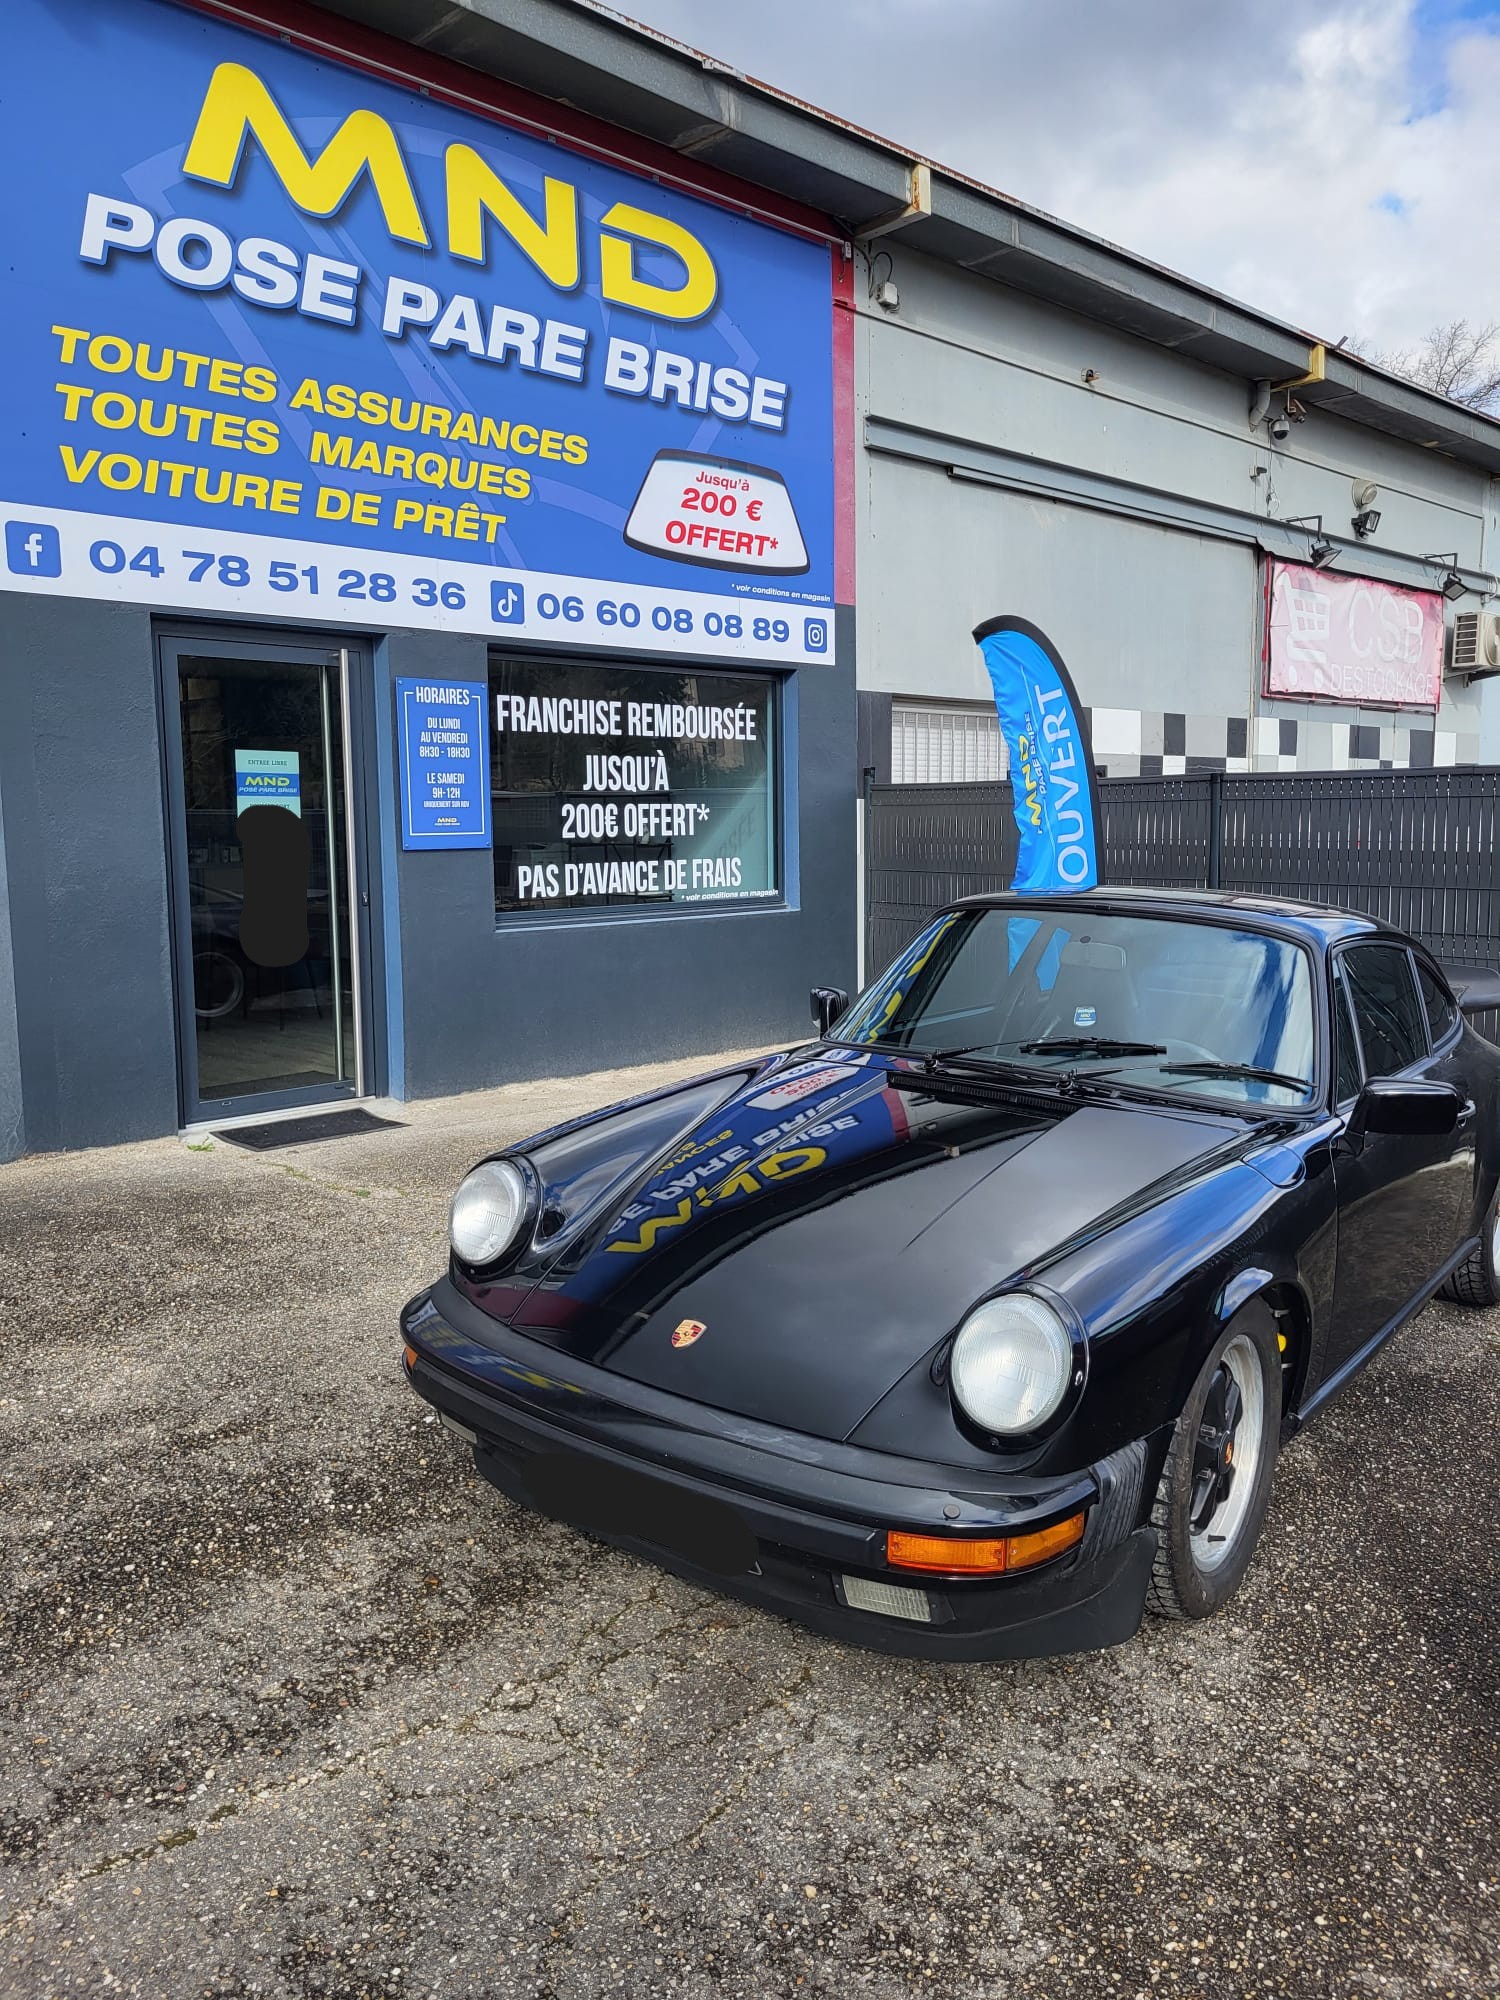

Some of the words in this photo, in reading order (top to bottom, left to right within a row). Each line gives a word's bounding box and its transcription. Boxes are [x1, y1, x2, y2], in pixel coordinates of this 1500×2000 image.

[182, 62, 718, 320] MND
[79, 193, 363, 325] POSE
[383, 278, 588, 379] PARE
[605, 338, 789, 430] BRISE
[51, 325, 277, 403] TOUTES
[290, 379, 589, 465] ASSURANCES
[55, 383, 280, 455] TOUTES
[310, 431, 532, 500] MARQUES
[59, 445, 302, 511] VOITURE
[316, 486, 380, 526] DE
[394, 502, 507, 546] PRÊT
[696, 471, 750, 492] Jusqu'à
[681, 487, 737, 517] 200
[746, 500, 763, 522] €
[88, 539, 165, 579] 04
[181, 552, 251, 588] 78
[268, 562, 321, 596] 51
[338, 570, 398, 604] 28
[411, 577, 467, 611] 36
[736, 584, 751, 593] voir
[752, 585, 790, 598] conditions
[801, 593, 831, 603] magasin
[536, 591, 586, 623] 06
[596, 599, 641, 628] 60
[652, 606, 694, 633] 08
[703, 612, 743, 638] 08
[753, 618, 789, 642] 89
[1348, 589, 1424, 664] CSB
[416, 686, 470, 705] HORAIRES
[1330, 664, 1434, 698] DESTOCKAGE
[427, 717, 438, 729] DU
[439, 717, 461, 730] LUNDI
[496, 694, 622, 736] FRANCHISE
[627, 702, 757, 741] REMBOURSÉE
[419, 746, 440, 758] 8H30
[447, 747, 470, 758] 18H30
[420, 732, 431, 743] AU
[432, 732, 468, 744] VENDREDI
[245, 776, 290, 786] MND
[427, 772, 436, 784] LE
[437, 773, 465, 785] SAMEDI
[583, 750, 669, 792] JUSQU'À
[1018, 734, 1042, 826] MND
[1032, 758, 1047, 795] PARE
[1035, 685, 1089, 884] OUVERT
[561, 803, 619, 839] 200€
[518, 864, 560, 899] PAS
[564, 860, 659, 897] D'AVANCE
[664, 859, 688, 891] DE
[692, 857, 742, 889] FRAIS
[701, 891, 739, 900] conditions
